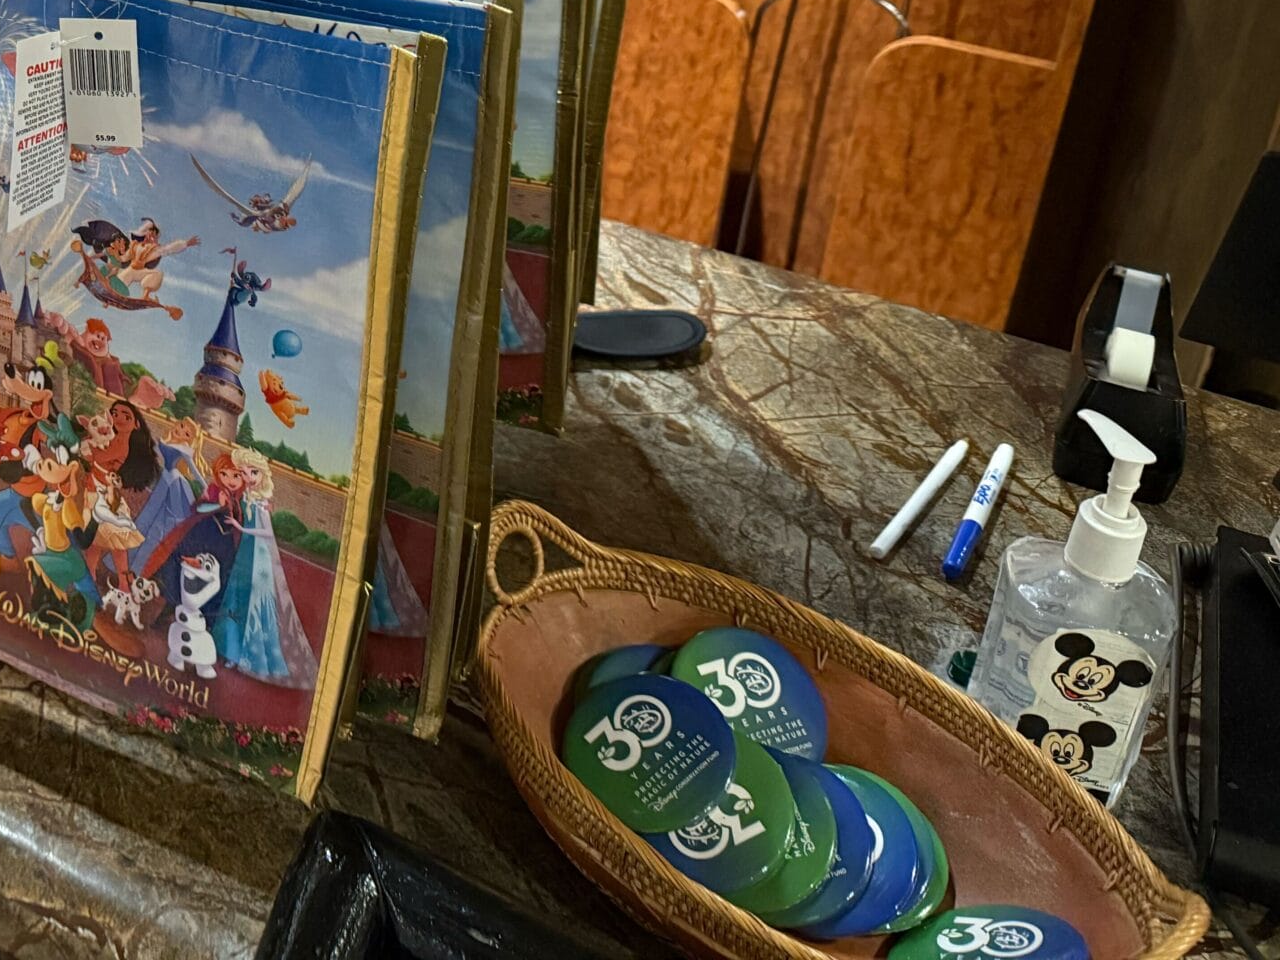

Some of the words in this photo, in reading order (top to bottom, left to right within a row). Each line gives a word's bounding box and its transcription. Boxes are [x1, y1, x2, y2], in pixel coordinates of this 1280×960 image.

[26, 58, 63, 77] CAUTI
[144, 660, 210, 709] World
[583, 694, 672, 772] 30
[746, 725, 783, 741] ECTING
[785, 718, 804, 730] THE
[630, 730, 686, 780] YEARS
[634, 750, 686, 798] PROTECTING
[686, 734, 704, 750] THE
[640, 779, 667, 805] MAGIC
[667, 768, 679, 781] OF
[679, 740, 711, 769] NATURE
[937, 916, 1043, 957] 30
